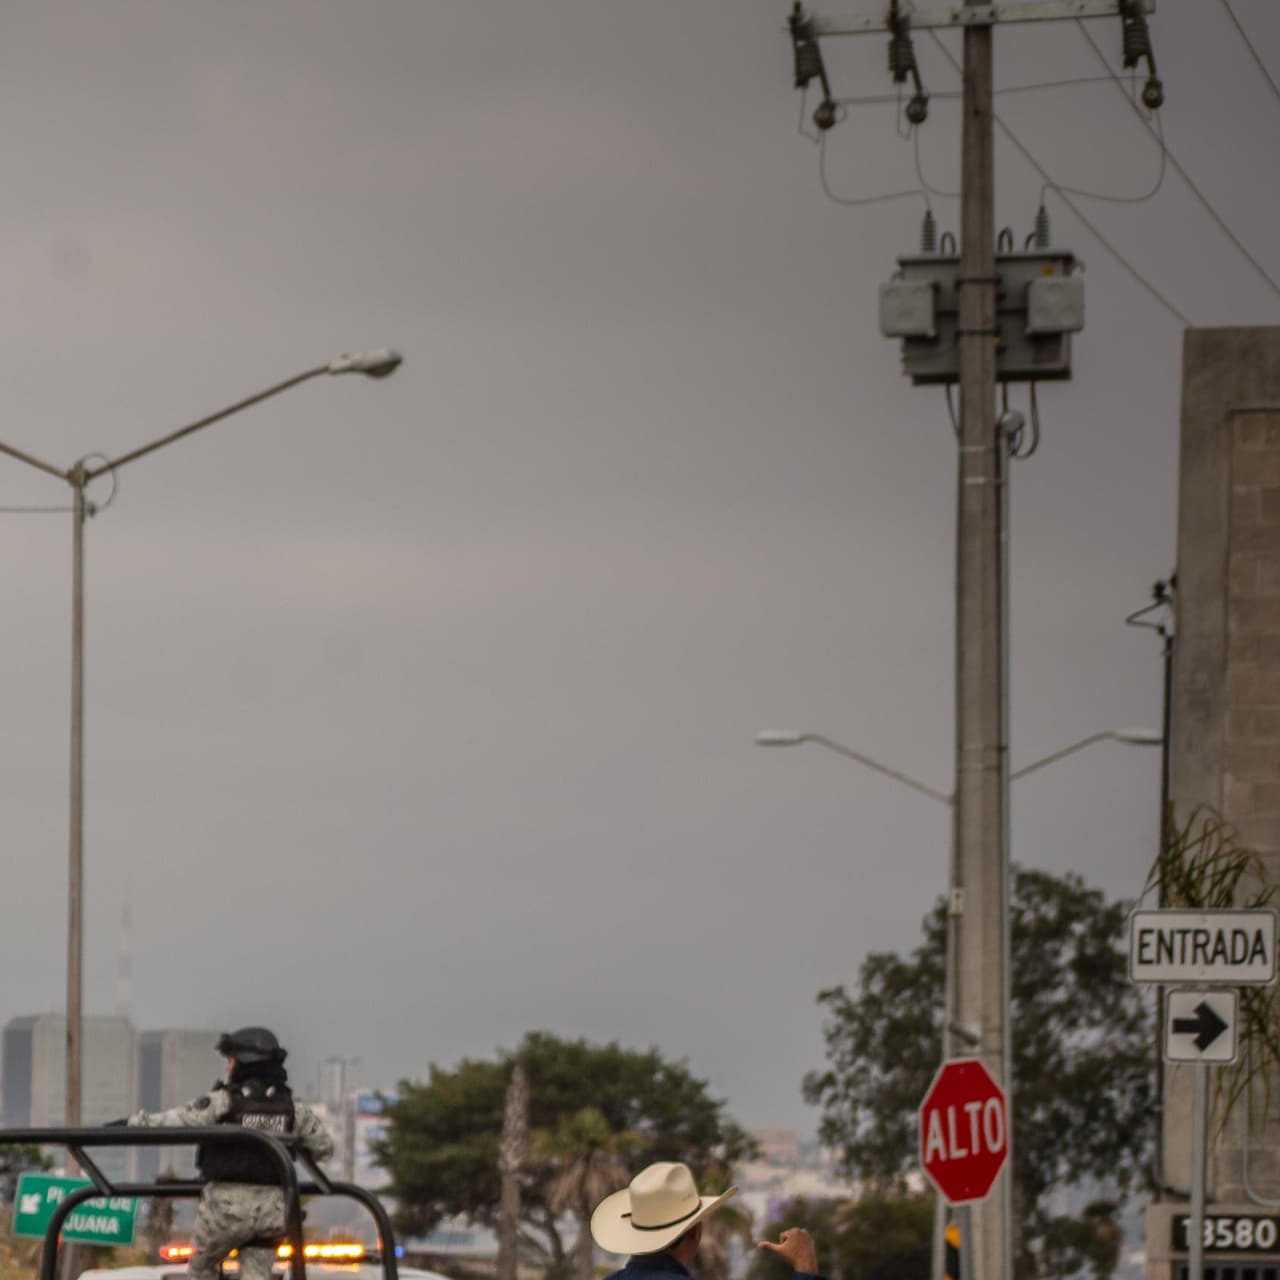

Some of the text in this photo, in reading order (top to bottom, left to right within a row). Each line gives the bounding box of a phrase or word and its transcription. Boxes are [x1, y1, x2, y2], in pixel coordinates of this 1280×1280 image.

[1137, 928, 1268, 966] ENTRADA
[924, 1097, 1006, 1164] ALTO
[109, 1195, 132, 1212] DE
[64, 1213, 119, 1235] JUANA
